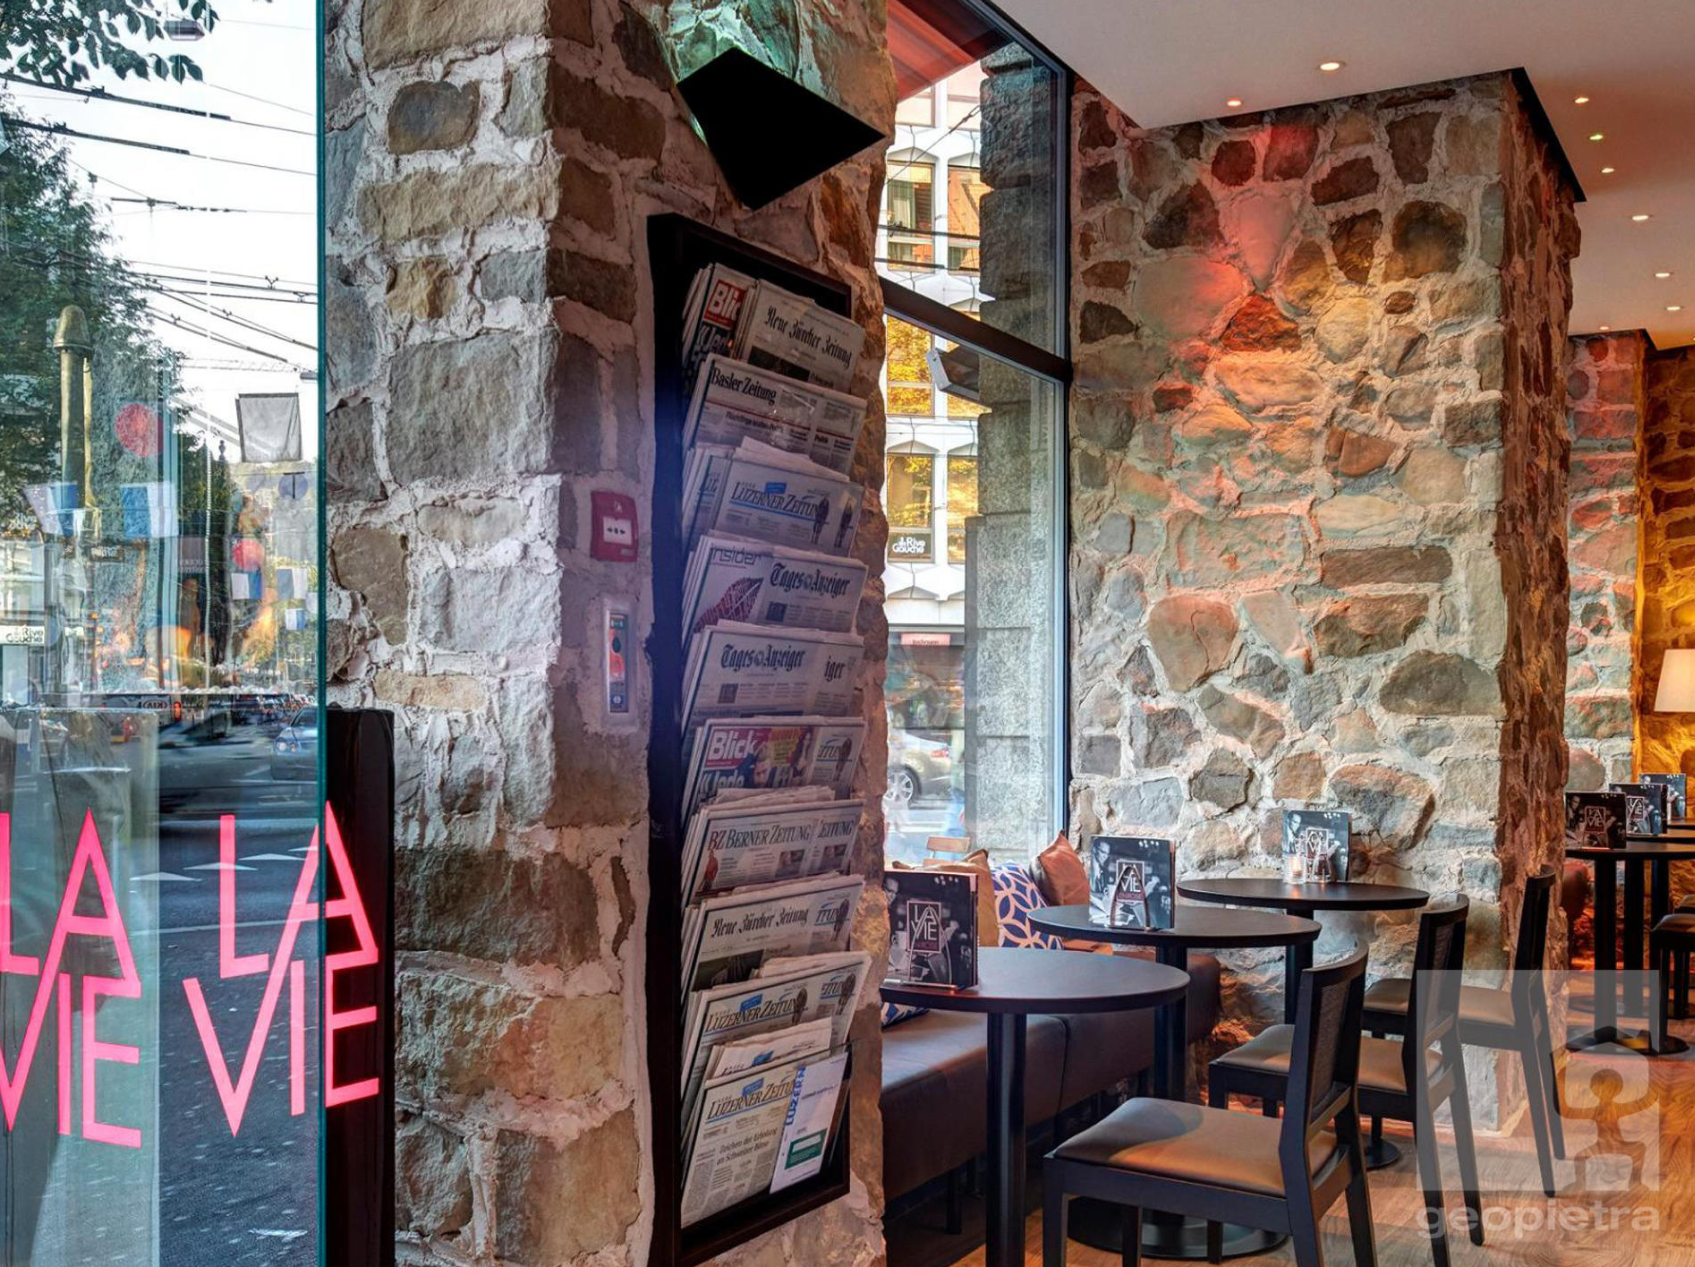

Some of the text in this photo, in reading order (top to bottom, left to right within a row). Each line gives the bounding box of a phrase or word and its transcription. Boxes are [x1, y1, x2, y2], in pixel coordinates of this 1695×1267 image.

[708, 283, 742, 319] Blic
[711, 367, 744, 392] Basler
[742, 377, 776, 405] Zeitung
[730, 482, 784, 511] LUZERNER
[782, 494, 819, 518] ZEITUN
[770, 562, 804, 593] Tages
[721, 643, 807, 672] Tages Anzeiger
[708, 729, 758, 760] Blick
[708, 822, 812, 851] BZ BERNER ZEITUNG
[219, 801, 379, 978] LA
[911, 920, 938, 941] VIE
[705, 1007, 762, 1033] LUZERNER
[759, 997, 798, 1019] ZEITUN
[183, 962, 379, 1137] VIE
[707, 1090, 763, 1120] LUZERNER
[761, 1079, 795, 1103] ZEITU
[785, 1065, 807, 1126] LUZERN
